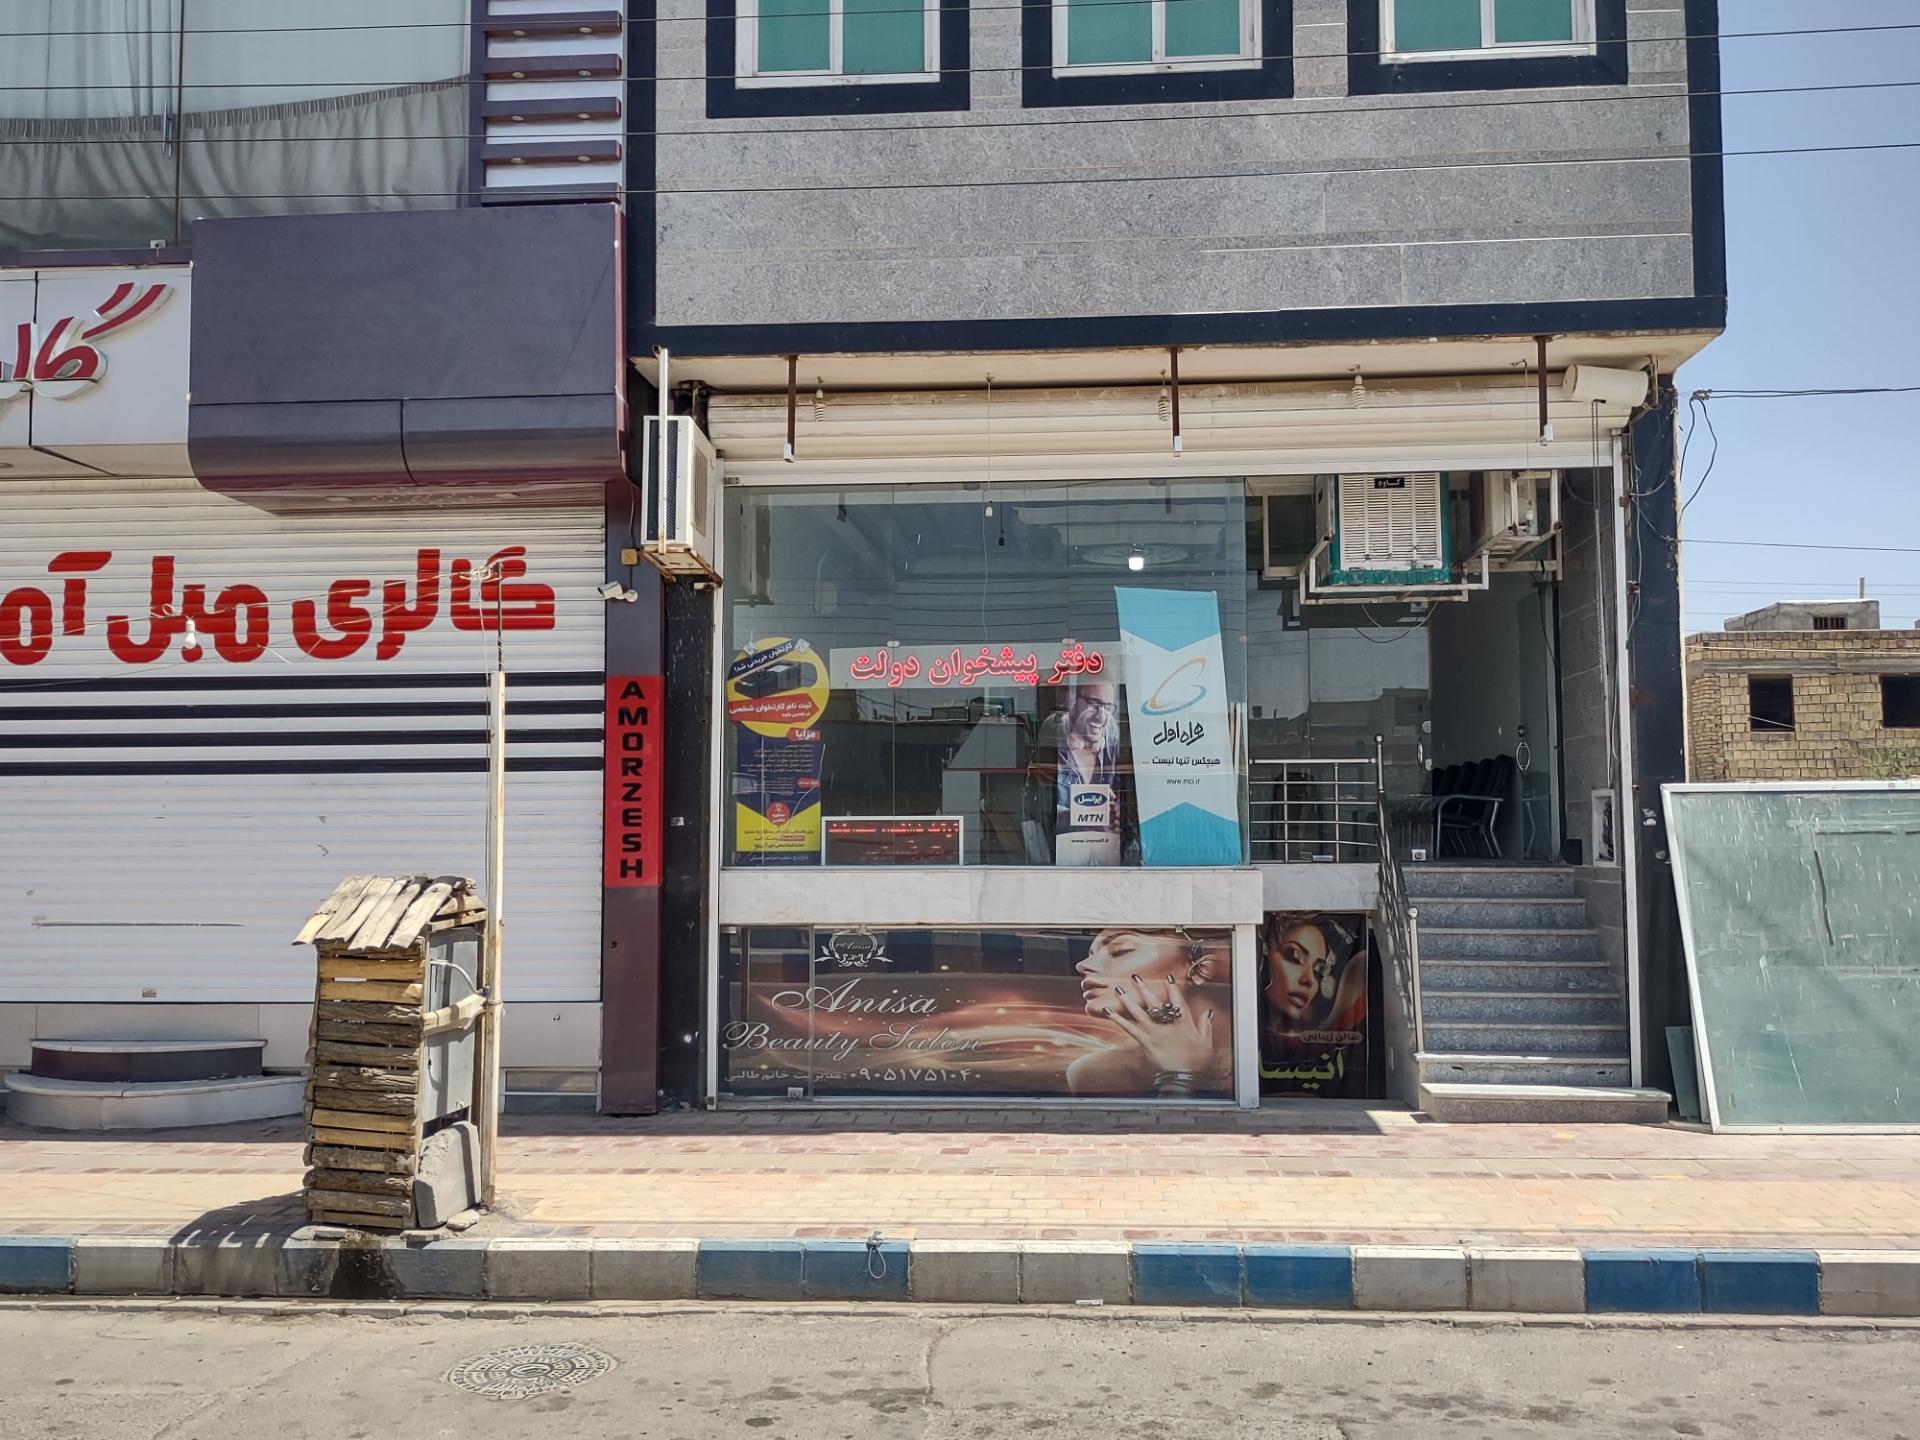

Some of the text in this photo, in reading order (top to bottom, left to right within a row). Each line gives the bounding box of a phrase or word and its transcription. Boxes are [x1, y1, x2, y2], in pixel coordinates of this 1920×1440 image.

[0, 281, 171, 390] گال
[0, 545, 556, 665] گالری مبل آم
[769, 642, 793, 659] کارتخوان
[850, 643, 1103, 687] دفتر پیشخوان دولت
[729, 701, 812, 714] ثبت نام کارتخوان شخصی
[795, 729, 816, 740] مزایا
[1153, 720, 1205, 746] همراه اول
[1152, 756, 1174, 767] نیست
[1175, 756, 1190, 766] تنها
[1192, 756, 1221, 768] هیچکس
[618, 681, 648, 878] AMORZESH
[1077, 794, 1103, 805] ایرانسل
[1077, 814, 1104, 822] MTN
[771, 977, 938, 1014] Anisa
[722, 1021, 985, 1061] Beauty Salon
[1258, 1046, 1345, 1090] آنیسا
[724, 1070, 760, 1082] طالبی
[761, 1071, 789, 1081] خانم
